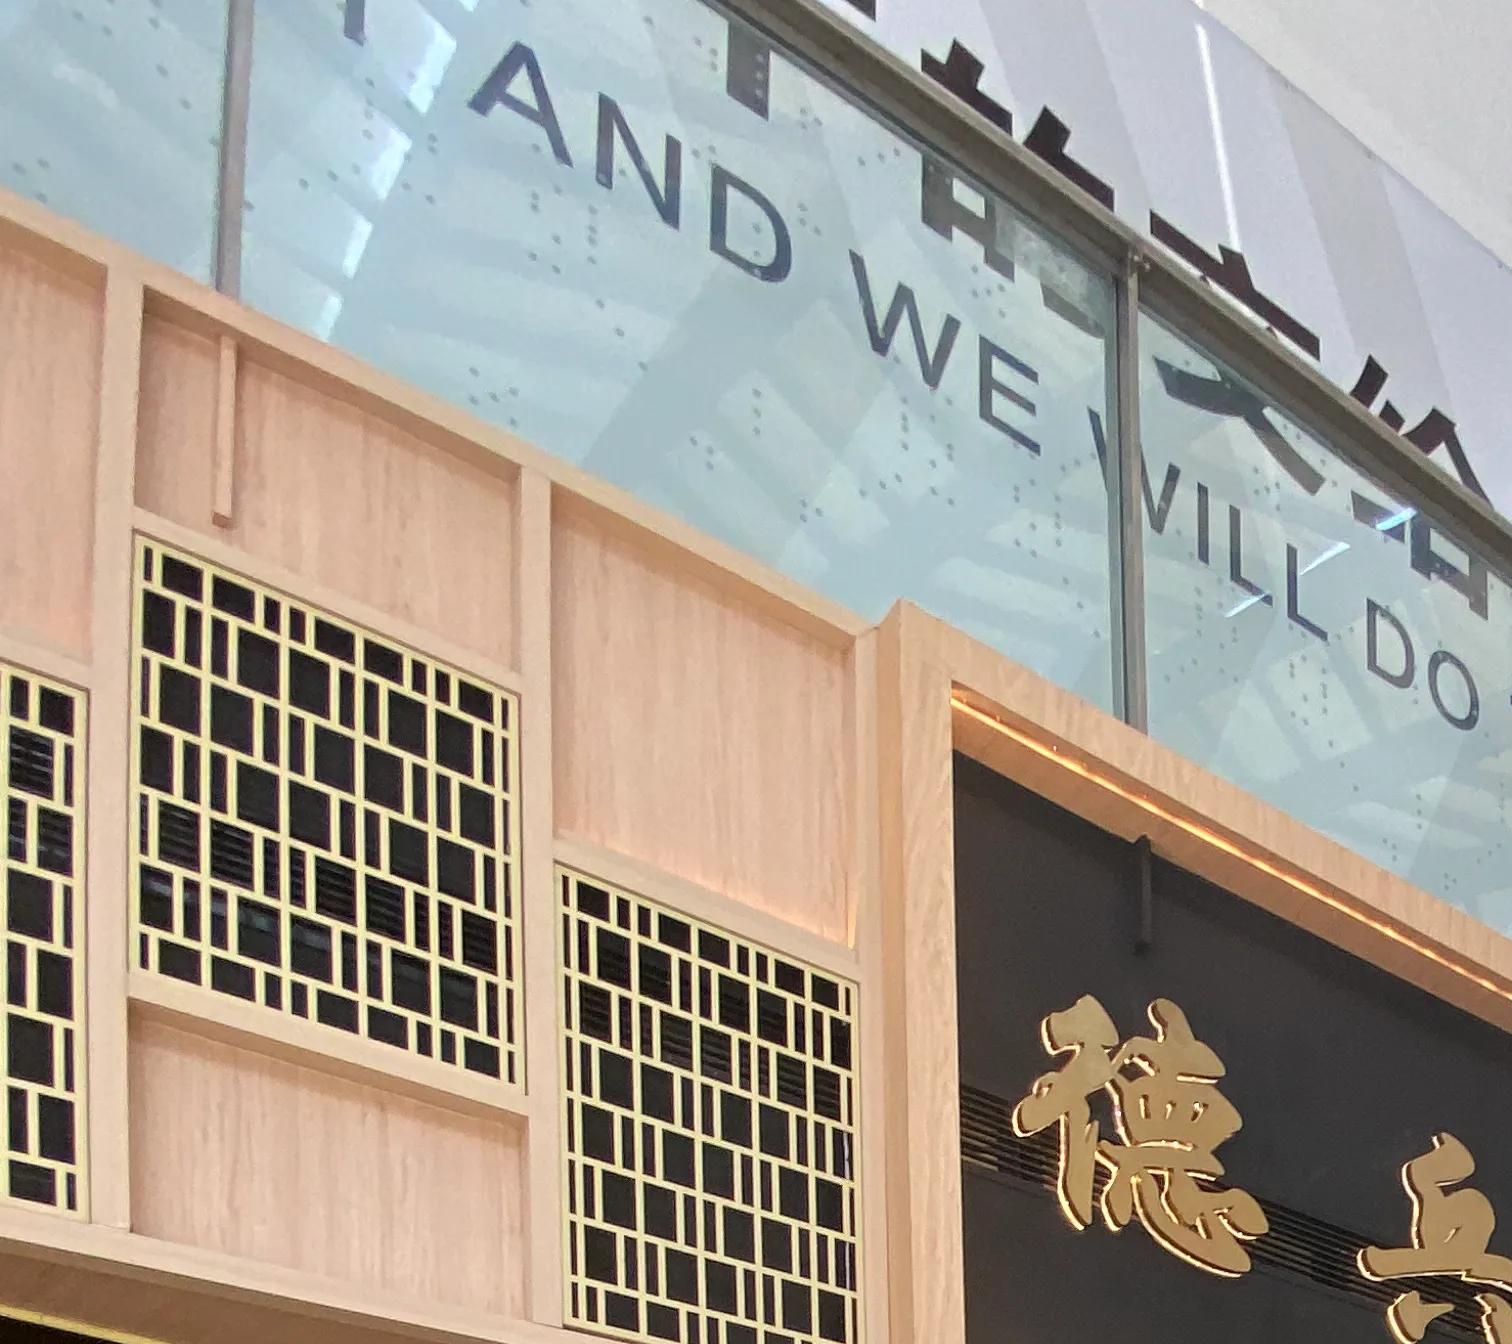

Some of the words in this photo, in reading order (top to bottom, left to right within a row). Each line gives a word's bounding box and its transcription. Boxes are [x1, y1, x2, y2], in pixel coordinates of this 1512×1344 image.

[467, 40, 793, 284] AND
[848, 248, 1042, 457] WE
[1086, 404, 1329, 643] WILL
[1366, 597, 1480, 731] DO
